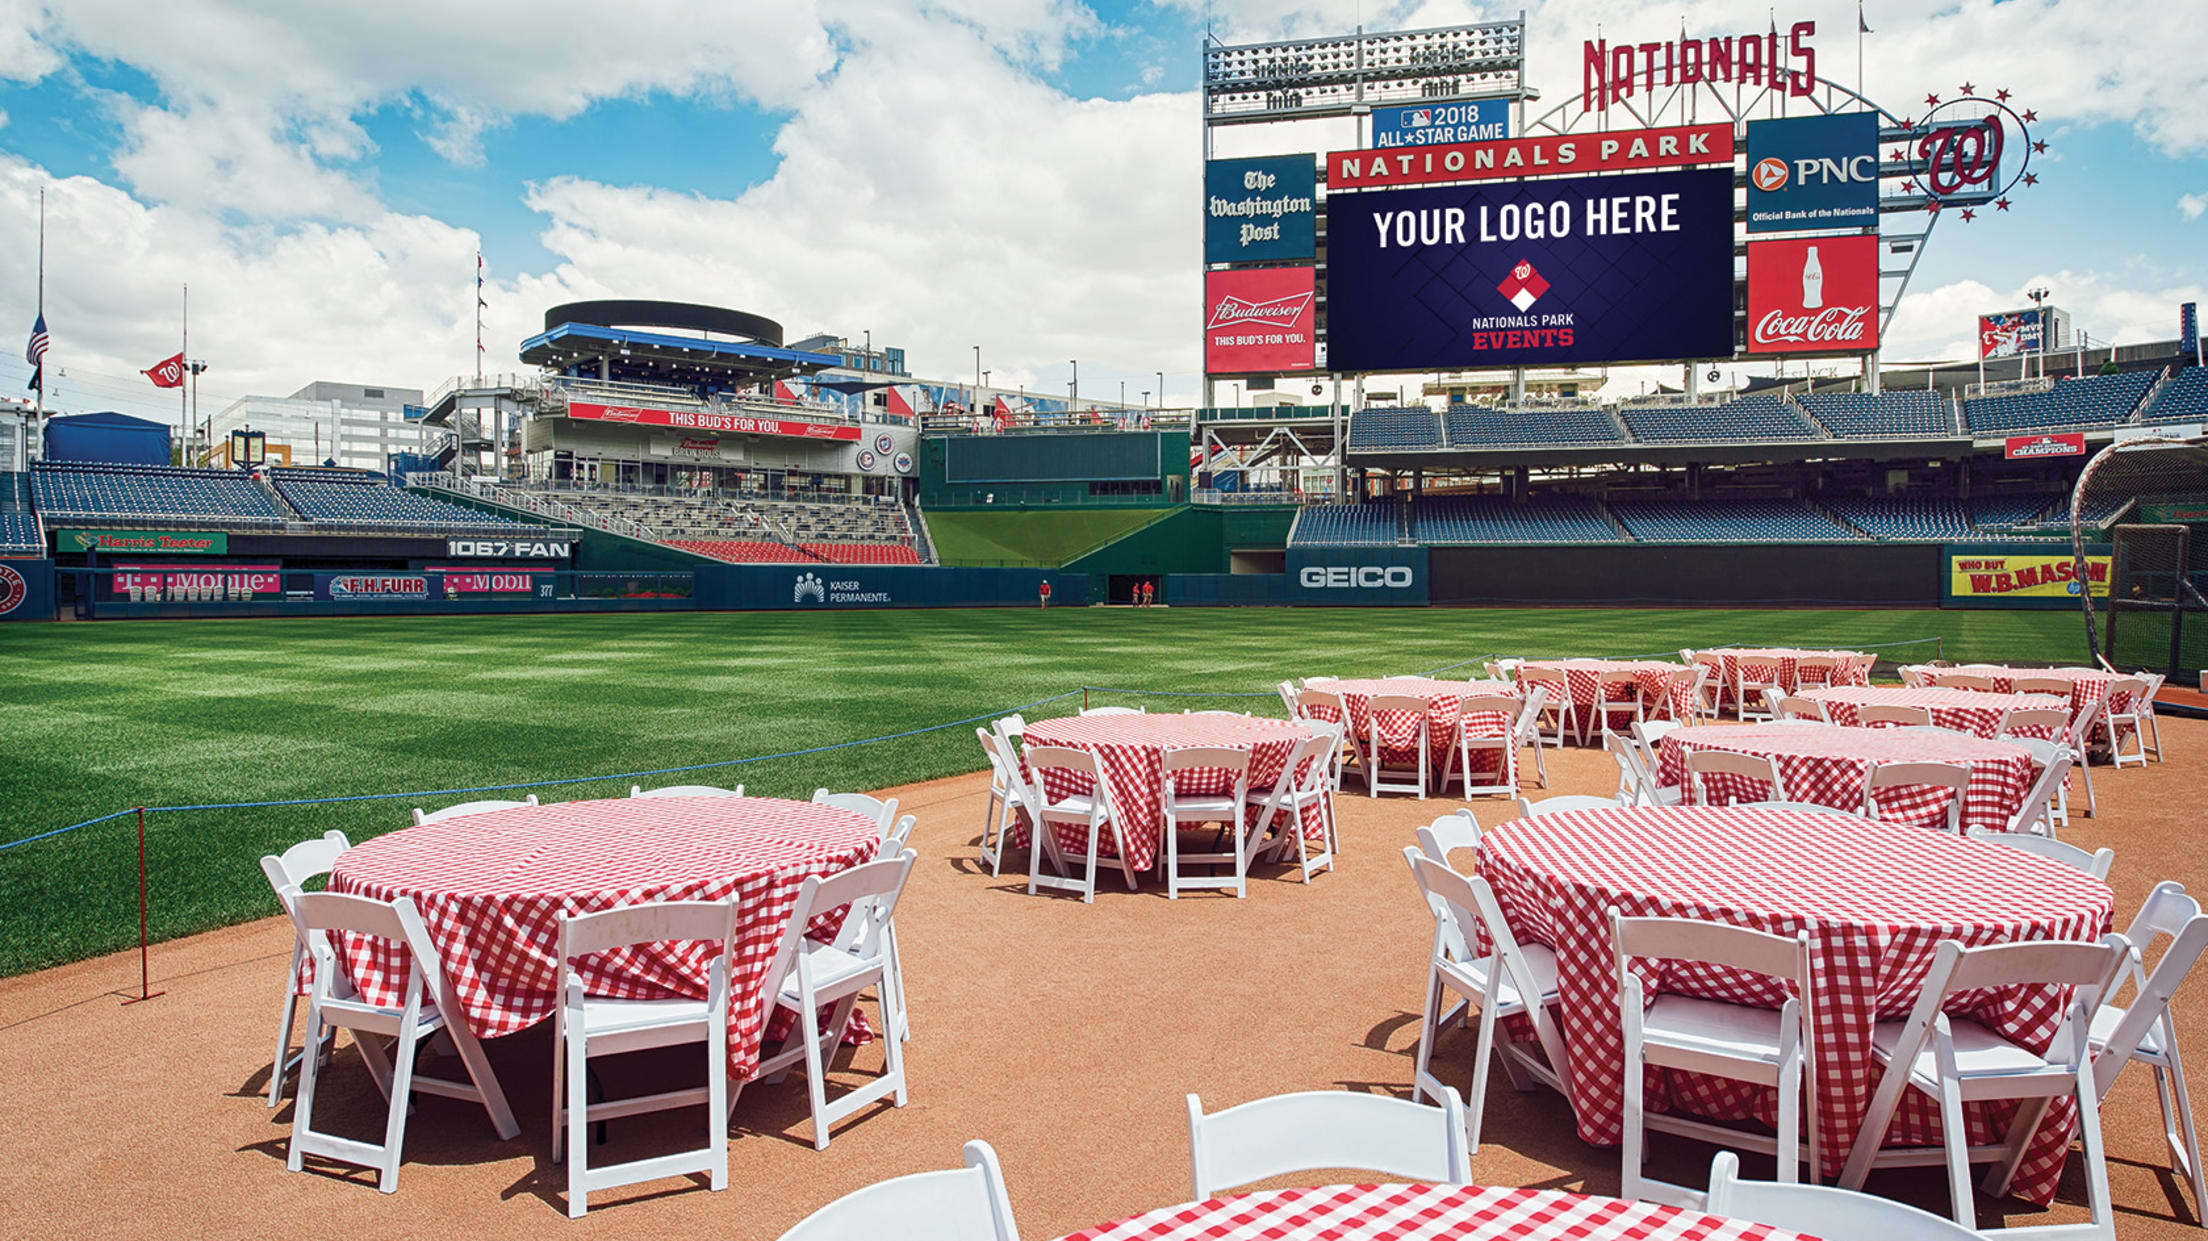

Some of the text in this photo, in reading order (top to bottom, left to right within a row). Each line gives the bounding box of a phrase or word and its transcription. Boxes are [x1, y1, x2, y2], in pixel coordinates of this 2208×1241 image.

[1583, 20, 1816, 112] NATIONALS
[1434, 105, 1479, 126] 2018
[1457, 122, 1504, 142] GAME
[1342, 132, 1710, 179] NATIONALS PARK
[1243, 170, 1276, 192] The
[1793, 154, 1875, 187] PNC
[1209, 196, 1312, 220] Washington
[1752, 206, 1874, 222] Official Bank of the Nationals
[1373, 193, 1681, 248] YOUR LOGO HERE
[1240, 222, 1280, 247] Post
[1215, 302, 1302, 321] Budweiser
[1472, 313, 1574, 330] NATIONALS PARK
[1754, 305, 1872, 344] Coca-Cola
[1214, 336, 1235, 346] THIS
[1236, 335, 1264, 346] BUD'S
[1265, 334, 1283, 344] FOR
[1472, 328, 1574, 351] EVENTS
[669, 412, 782, 433] THIS BUD'S FOR YOU.
[98, 535, 212, 549] Harris Teeter
[515, 543, 569, 557] FAN
[1958, 559, 2006, 570] WHO BUY
[830, 581, 859, 590] KAISER
[1300, 566, 1413, 588] GEICO
[830, 592, 888, 602] PERMANENTE
